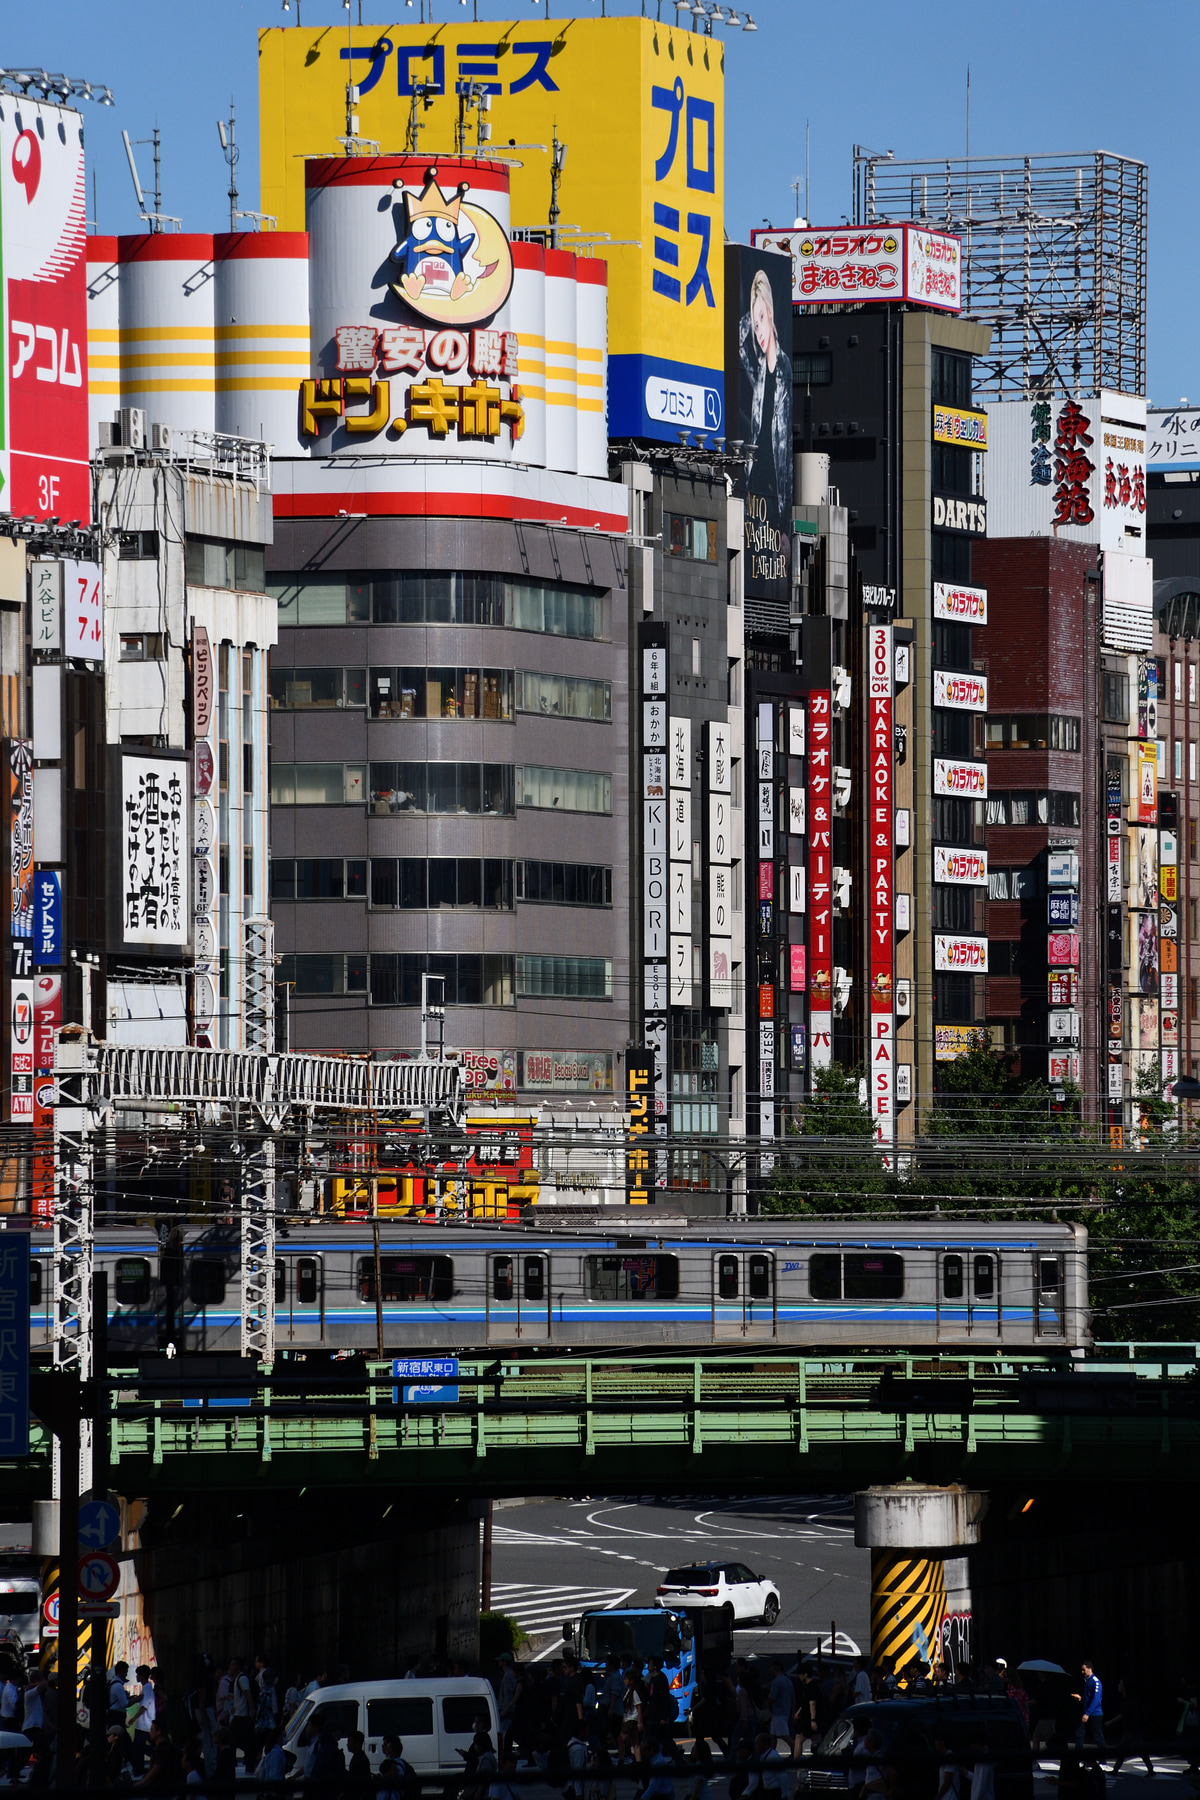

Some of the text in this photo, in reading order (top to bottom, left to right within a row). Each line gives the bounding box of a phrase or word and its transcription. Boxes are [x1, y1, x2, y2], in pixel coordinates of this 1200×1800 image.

[340, 38, 560, 97] プロミス
[651, 76, 715, 194] プロ
[653, 201, 716, 308] ミス
[814, 235, 884, 258] カラオケ
[929, 240, 953, 261] カラオケ
[800, 261, 898, 295] まねきねこ
[925, 264, 956, 299] まねきねこ
[12, 319, 82, 388] アコム
[335, 326, 519, 376] 驚安の殿堂
[659, 388, 695, 420] プロミス
[934, 410, 953, 438] 麻雀
[1052, 400, 1096, 524] 東海苑
[38, 475, 60, 511] 3F
[1103, 457, 1146, 513] 東海苑
[746, 491, 767, 522] MIO
[934, 497, 986, 533] DARTS
[744, 521, 781, 552] YASHIRO
[751, 555, 787, 580] L'ATELIER
[37, 569, 56, 641] 戸谷ビル
[78, 577, 100, 606] アイ
[951, 591, 980, 616] カラオケ
[78, 616, 102, 642] フル
[874, 629, 887, 675] 300
[650, 652, 659, 691] 6年4組
[871, 683, 889, 693] OK
[951, 679, 980, 703] カラオケ
[650, 705, 661, 743] おかか
[654, 757, 662, 783] 北海道
[951, 768, 980, 791] カラオケ
[875, 699, 889, 944] KARAOKE & PARTY
[125, 794, 141, 929] だけの店
[139, 772, 160, 930] 酒と肴
[648, 805, 662, 951] KIBORI
[951, 856, 981, 879] カラオケ
[1166, 867, 1176, 898] 千里香
[41, 881, 56, 954] セントラル
[196, 903, 209, 911] 6F
[1050, 899, 1069, 910] 麻雀
[13, 942, 33, 975] 7F
[952, 943, 981, 967] カラオケ
[41, 1010, 54, 1053] アコム
[763, 1025, 774, 1055] ZEST
[13, 1055, 32, 1071] たばこ
[41, 1056, 54, 1065] 3F
[464, 1051, 498, 1069] Free
[464, 1069, 487, 1086] op
[13, 1097, 32, 1113] ATM
[396, 1361, 454, 1374] 新宿駅東口
